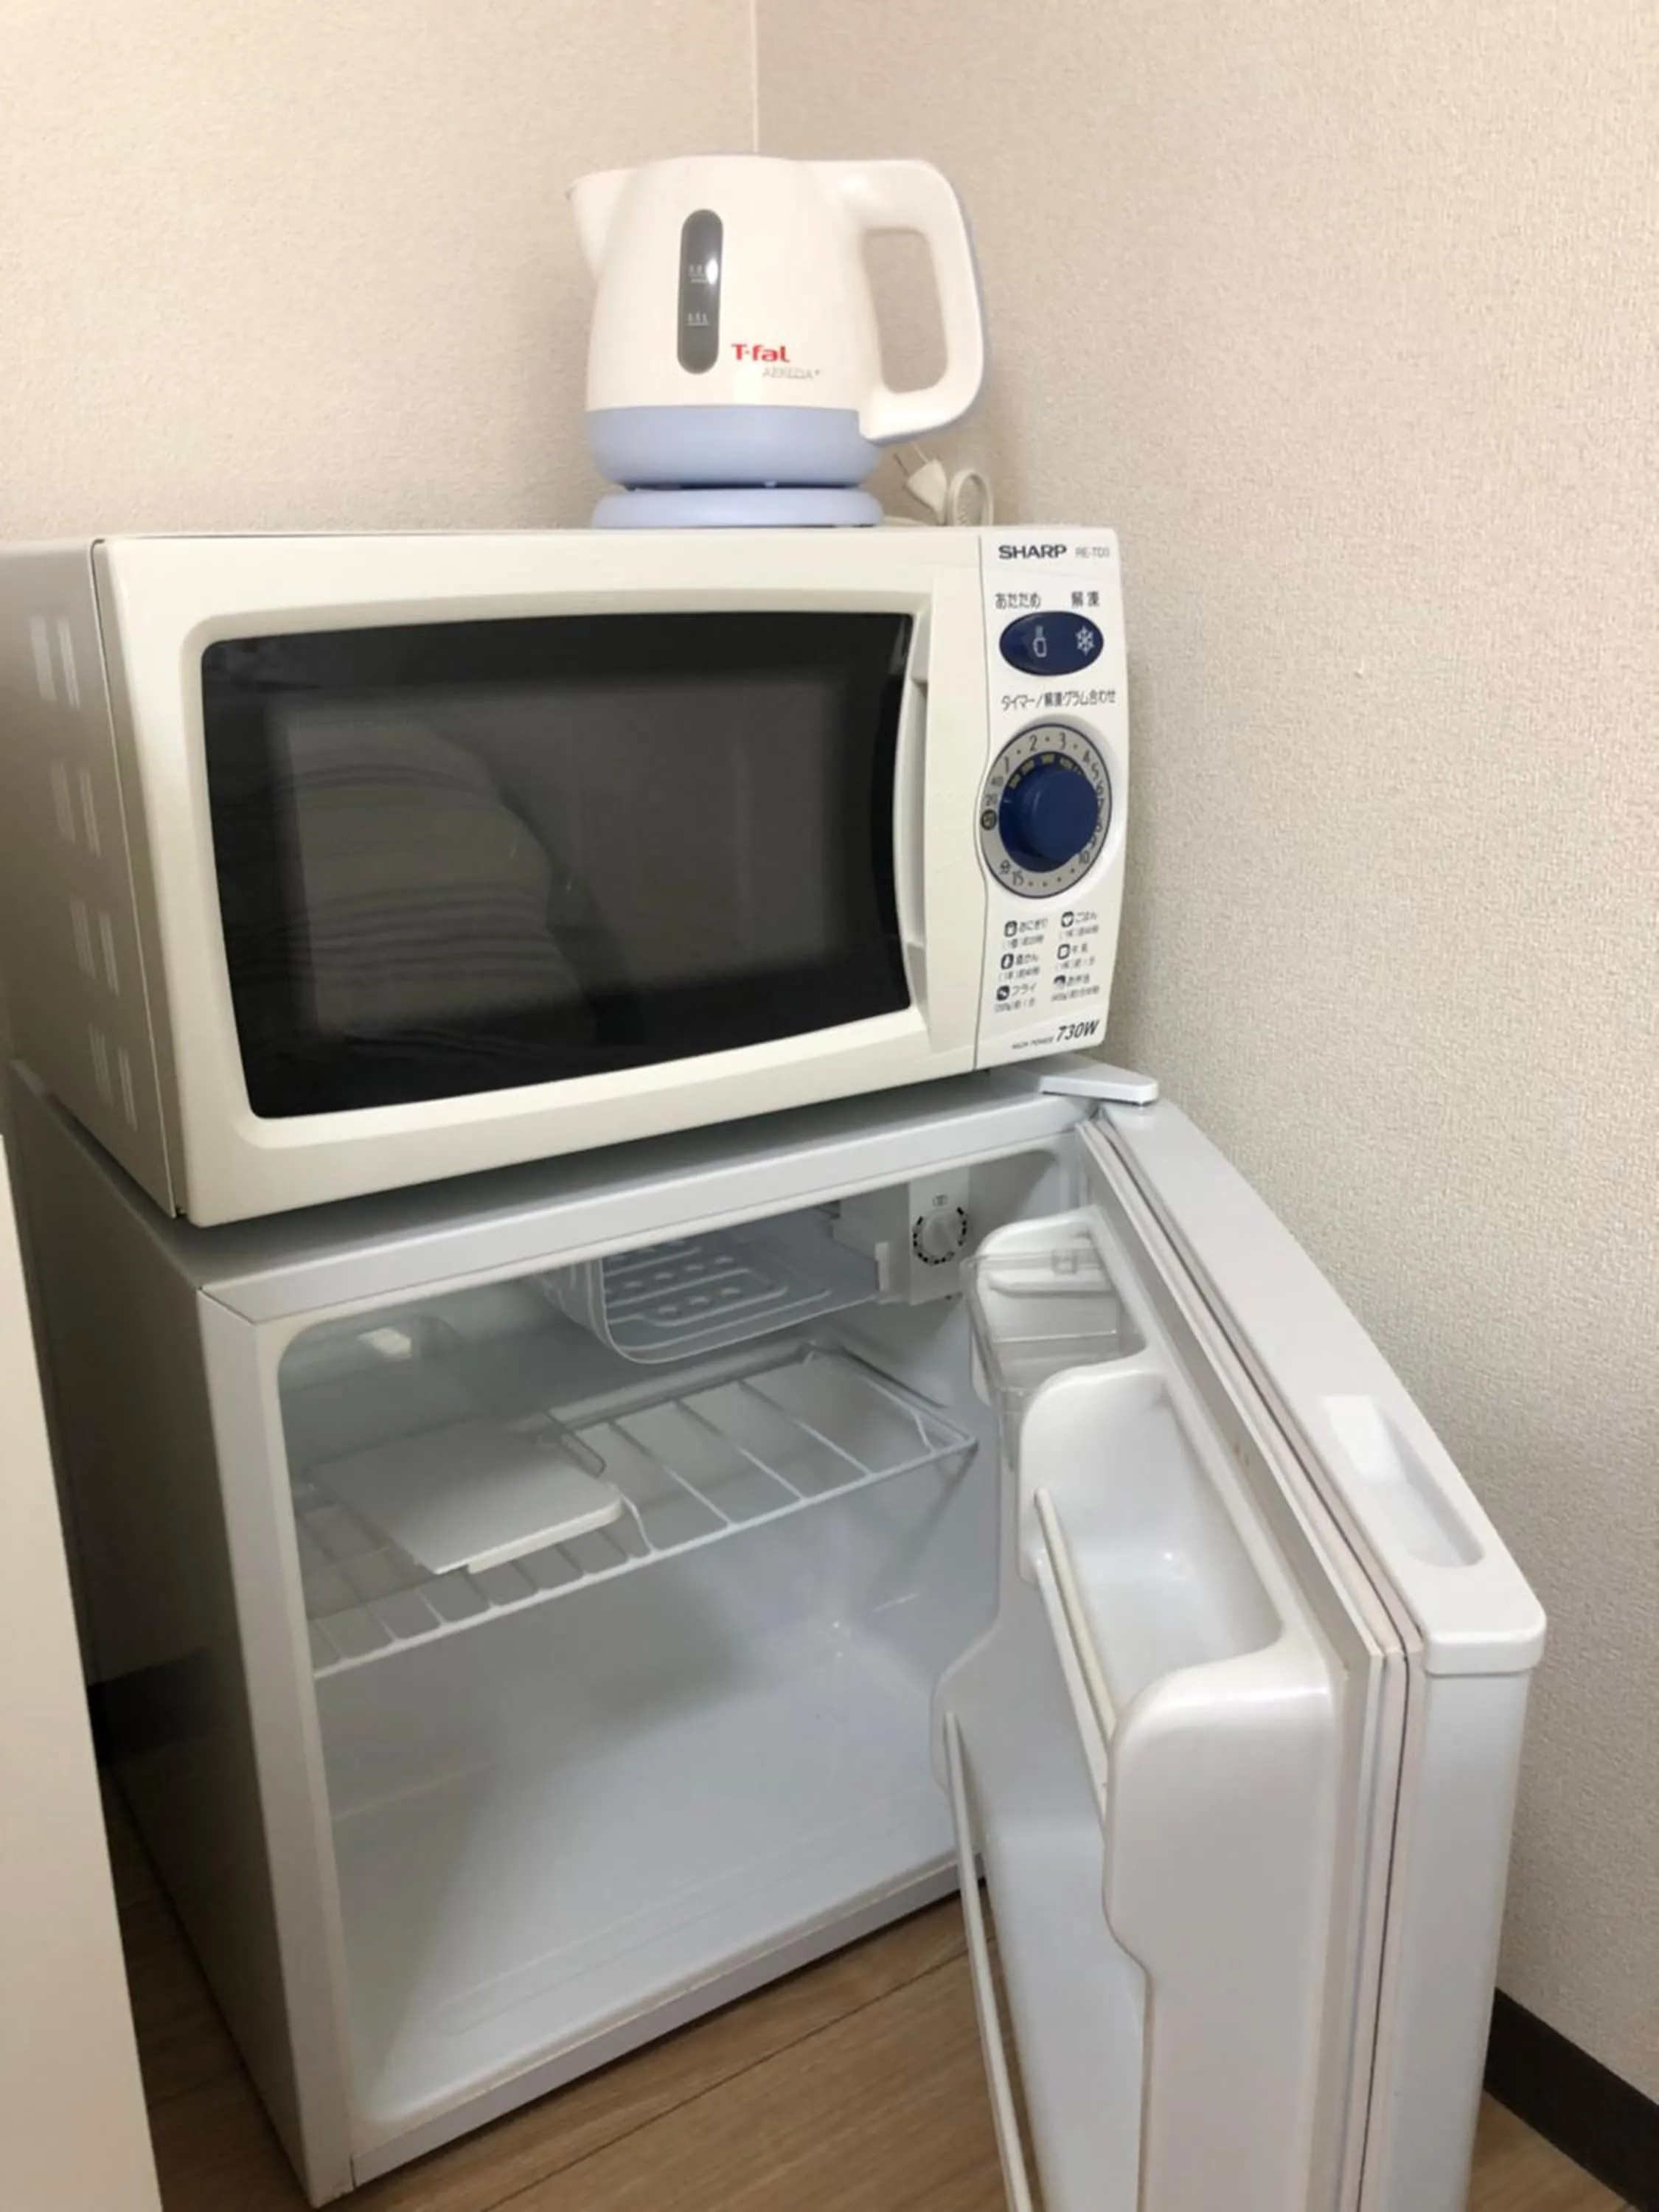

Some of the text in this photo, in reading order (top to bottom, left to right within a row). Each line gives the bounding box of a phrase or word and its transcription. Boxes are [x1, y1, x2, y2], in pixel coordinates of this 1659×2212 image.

[731, 343, 790, 363] T-fal
[998, 544, 1067, 560] SHARP
[996, 591, 1100, 609] あたため 解凍
[1029, 734, 1037, 751] 2
[1059, 732, 1066, 750] 3
[1004, 757, 1010, 773] 1
[1079, 851, 1090, 865] 10
[1012, 870, 1024, 886] 15
[1011, 982, 1037, 996] フライ
[1056, 1019, 1100, 1042] 730W
